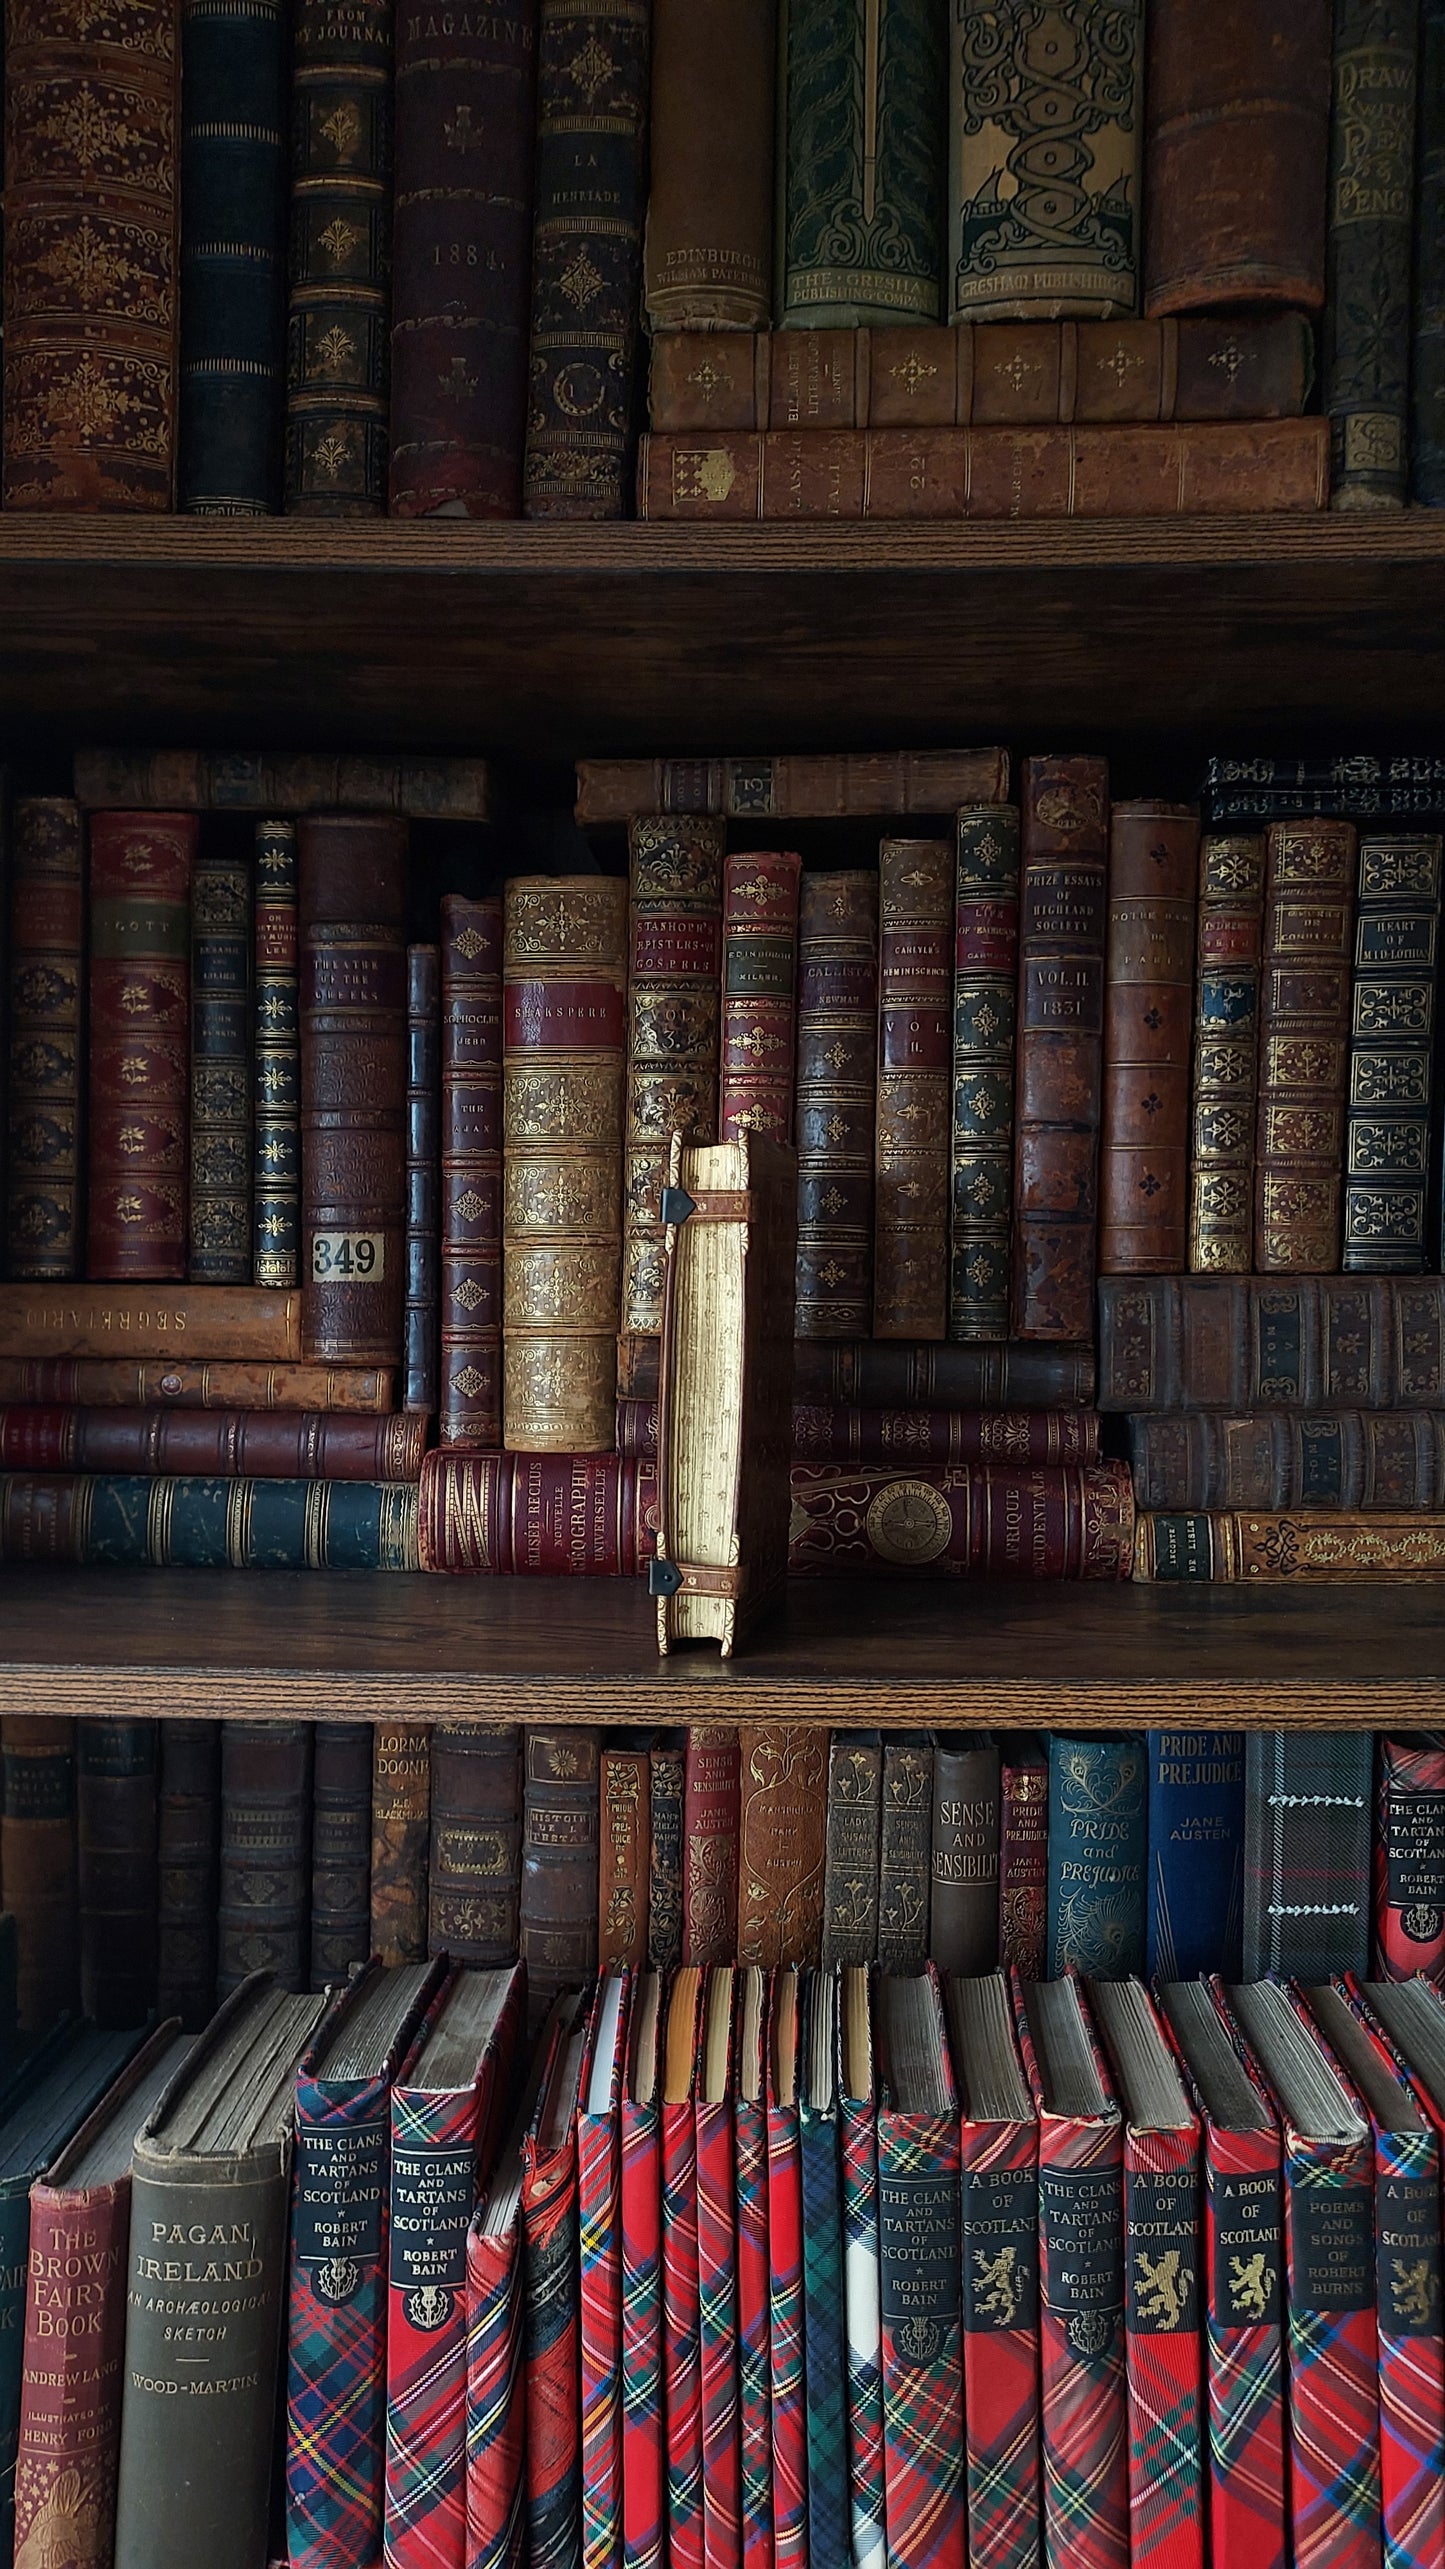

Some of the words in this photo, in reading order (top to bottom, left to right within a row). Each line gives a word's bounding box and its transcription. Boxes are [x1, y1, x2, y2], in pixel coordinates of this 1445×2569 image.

[327, 11, 366, 22] FROM
[408, 14, 533, 50] MAGAZINE
[574, 153, 597, 167] LA
[791, 270, 832, 288] THE
[910, 457, 925, 489] 22
[1027, 875, 1059, 888] PRIZE
[1064, 874, 1102, 887] ESSAYS
[1056, 890, 1072, 901] OF
[1033, 905, 1094, 917] HIGHLAND
[959, 926, 970, 935] OF
[1035, 920, 1089, 931] SOCIETY
[1377, 921, 1416, 932] HEART
[1386, 934, 1405, 945] OF
[728, 950, 792, 960] EDINBURGH
[313, 959, 378, 970] THEATRE
[636, 958, 710, 971] GOSPELS
[808, 966, 871, 978] CALLISTA
[321, 975, 335, 985] OF
[344, 974, 369, 985] THE
[315, 990, 378, 1001] GREEKS
[819, 995, 860, 1005] NEWMAN
[514, 1007, 607, 1018] SHAKSPERE
[1042, 1000, 1081, 1016] 1831
[461, 1104, 485, 1113] THE
[454, 1124, 490, 1133] AJAX
[314, 1239, 375, 1274] 349
[26, 1309, 187, 1331] SEGRETARIO
[1267, 1326, 1277, 1367] TOM
[528, 1461, 542, 1515] RECLUS
[553, 1486, 564, 1547] NOUVELLE
[594, 1468, 606, 1563] UNIVERSELLE
[1006, 1489, 1022, 1564] AFRIQUE
[1186, 1519, 1196, 1551] LISLE
[1188, 1560, 1197, 1572] DE
[379, 1736, 428, 1753] LORNA
[1160, 1735, 1208, 1757] PRIDE
[1212, 1734, 1243, 1755] AND
[698, 1757, 733, 1769] SENSE
[705, 1770, 726, 1780] AND
[1158, 1760, 1242, 1785] PREJUDICE
[693, 1779, 736, 1793] SENSIBILITY
[611, 1803, 633, 1813] PRIDE
[701, 1807, 728, 1818] JANE
[940, 1800, 995, 1828] SENSE
[1012, 1806, 1043, 1818] PRIDE
[1389, 1804, 1413, 1815] THE
[695, 1818, 734, 1830] AUSTEN
[844, 1817, 868, 1827] LADY
[1018, 1818, 1038, 1828] AND
[1180, 1817, 1224, 1828] JANE
[1411, 1817, 1434, 1825] AND
[1006, 1829, 1047, 1842] PREJUDICE
[1070, 1817, 1130, 1841] PRIDE
[1170, 1828, 1231, 1841] AUSTEN
[841, 1833, 872, 1843] SUSAN
[952, 1833, 986, 1848] AND
[1415, 1839, 1430, 1847] OF
[1083, 1844, 1117, 1860] and
[765, 1858, 803, 1868] AUSTEN
[1013, 1858, 1041, 1867] JANE
[1007, 1867, 1045, 1878] AUSTEN
[1060, 1861, 1142, 1889] PREJUDICE
[1400, 1874, 1445, 1884] ROBERT
[1408, 1885, 1437, 1895] BAIN
[304, 2136, 333, 2151] THE
[337, 2132, 384, 2151] CLANS
[330, 2151, 357, 2163] AND
[308, 2160, 378, 2178] TARTANS
[394, 2159, 420, 2176] THE
[424, 2159, 471, 2177] CLANS
[334, 2180, 350, 2190] OF
[417, 2177, 445, 2189] AND
[969, 2173, 984, 2189] A
[988, 2168, 1036, 2188] BOOK
[1133, 2174, 1148, 2189] A
[1153, 2171, 1198, 2189] BOOK
[303, 2186, 381, 2204] SCOTLAND
[1044, 2180, 1074, 2199] THE
[1078, 2180, 1122, 2198] CLANS
[1223, 2184, 1236, 2198] A
[1238, 2179, 1276, 2196] BOOK
[1386, 2184, 1399, 2199] A
[396, 2188, 467, 2204] TARTANS
[881, 2188, 910, 2205] THE
[991, 2194, 1014, 2209] OF
[1072, 2200, 1099, 2210] AND
[1155, 2197, 1177, 2211] OF
[1309, 2200, 1365, 2214] POEMS
[422, 2206, 438, 2217] OF
[906, 2207, 933, 2218] AND
[1050, 2208, 1121, 2226] TARTANS
[1241, 2204, 1261, 2219] OF
[1406, 2209, 1427, 2223] OF
[314, 2219, 368, 2234] ROBERT
[393, 2215, 470, 2232] SCOTLAND
[883, 2217, 955, 2233] TARTANS
[1321, 2218, 1354, 2231] AND
[50, 2227, 97, 2250] THE
[151, 2221, 250, 2245] PAGAN
[1078, 2227, 1095, 2238] OF
[1310, 2233, 1364, 2246] SONGS
[322, 2234, 358, 2248] BAIN
[911, 2234, 928, 2246] OF
[1048, 2236, 1122, 2254] SCOTLAND
[402, 2247, 458, 2262] ROBERT
[882, 2245, 957, 2260] SCOTLAND
[1328, 2250, 1349, 2263] OF
[29, 2247, 119, 2279] BROWN
[136, 2256, 264, 2283] IRELAND
[411, 2262, 448, 2276] BAIN
[1061, 2270, 1114, 2285] ROBERT
[1308, 2265, 1367, 2280] ROBERT
[891, 2278, 948, 2291] ROBERT
[1311, 2281, 1364, 2295] BURNS
[33, 2279, 111, 2309] FAIRY
[127, 2291, 143, 2305] AN
[901, 2291, 938, 2305] BAIN
[1070, 2285, 1105, 2299] BAIN
[36, 2309, 104, 2338] BOOK
[163, 2325, 228, 2342] SKETCH
[23, 2367, 81, 2388] ANDREW
[82, 2358, 119, 2383] LANG
[131, 2371, 258, 2396] WOOD-MARTIN
[27, 2410, 95, 2426] ILLUSTRATED
[97, 2402, 111, 2416] BY
[23, 2427, 68, 2446] HENRY
[76, 2417, 113, 2444] FORD
